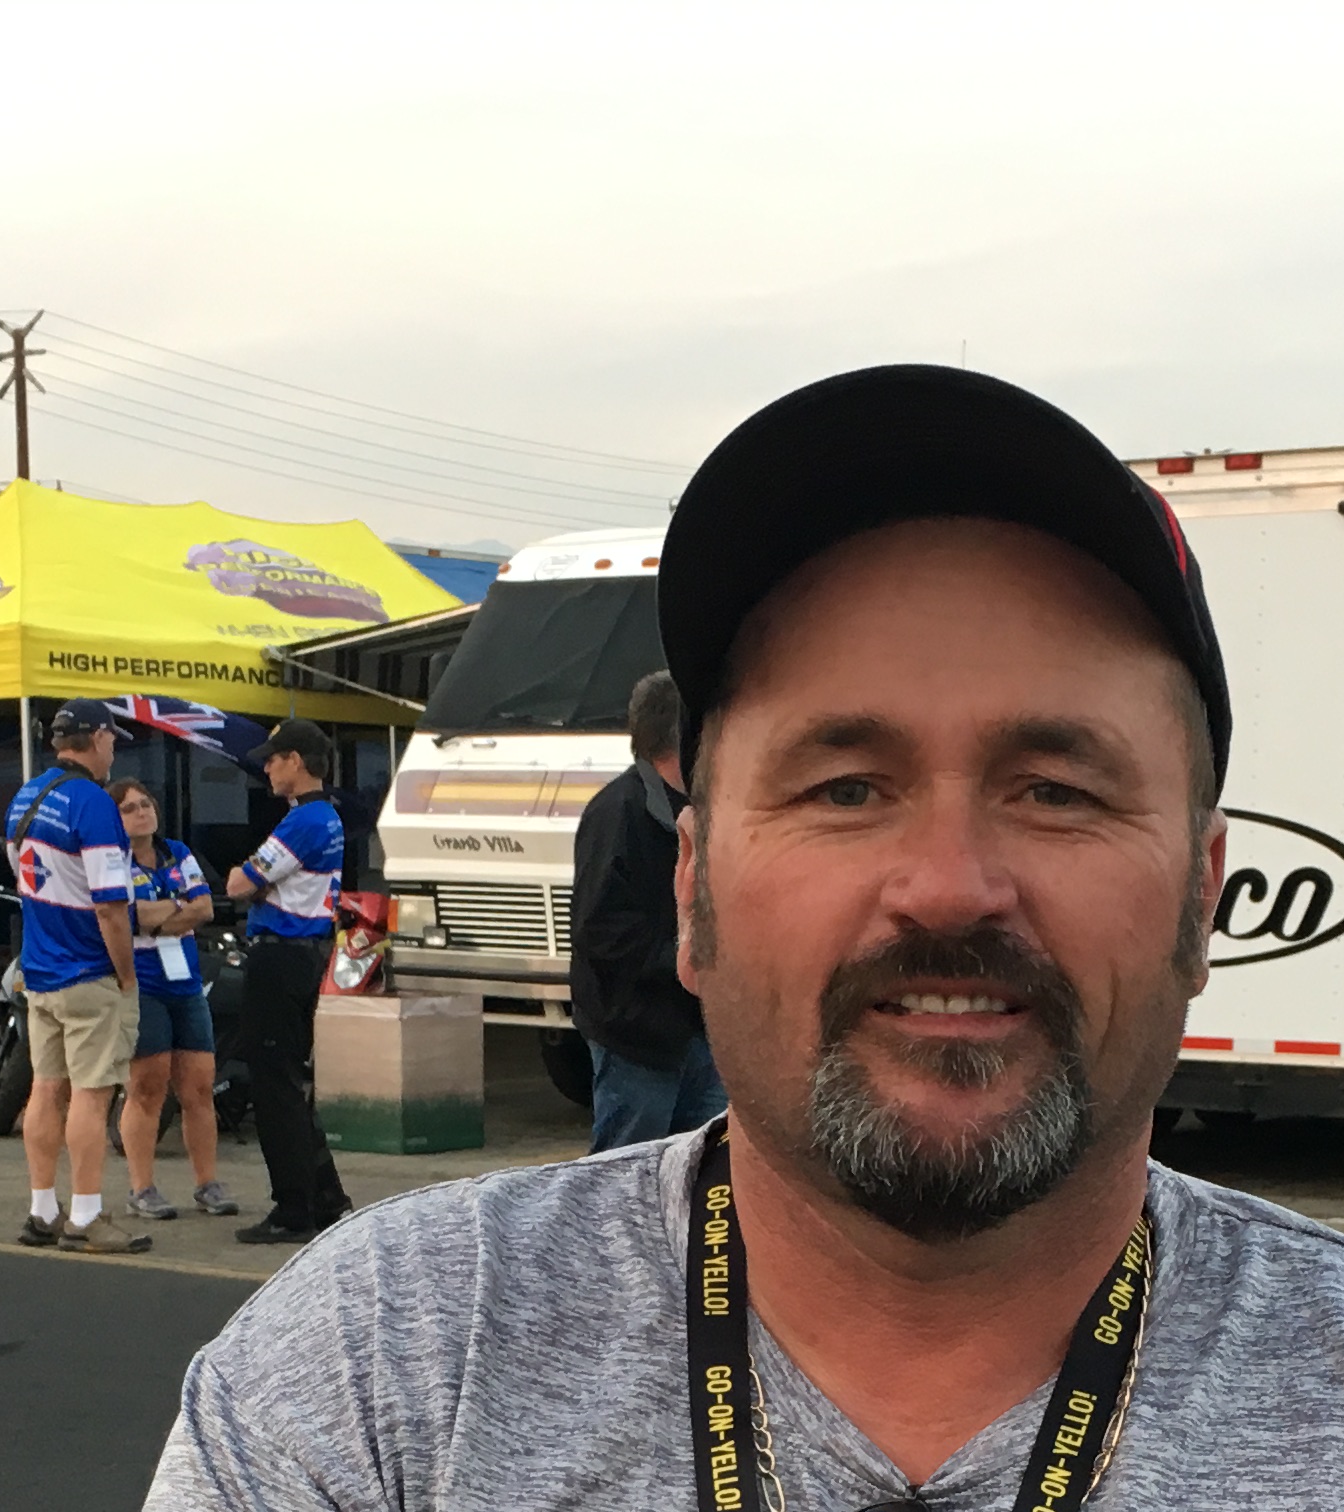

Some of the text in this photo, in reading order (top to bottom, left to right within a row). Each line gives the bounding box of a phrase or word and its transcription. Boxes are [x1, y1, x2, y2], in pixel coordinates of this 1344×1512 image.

[49, 650, 283, 689] HIGH PERFORMANC
[703, 1185, 731, 1316] GO-ON-YELLO!
[706, 1365, 742, 1511] GO-ON-YELLO!
